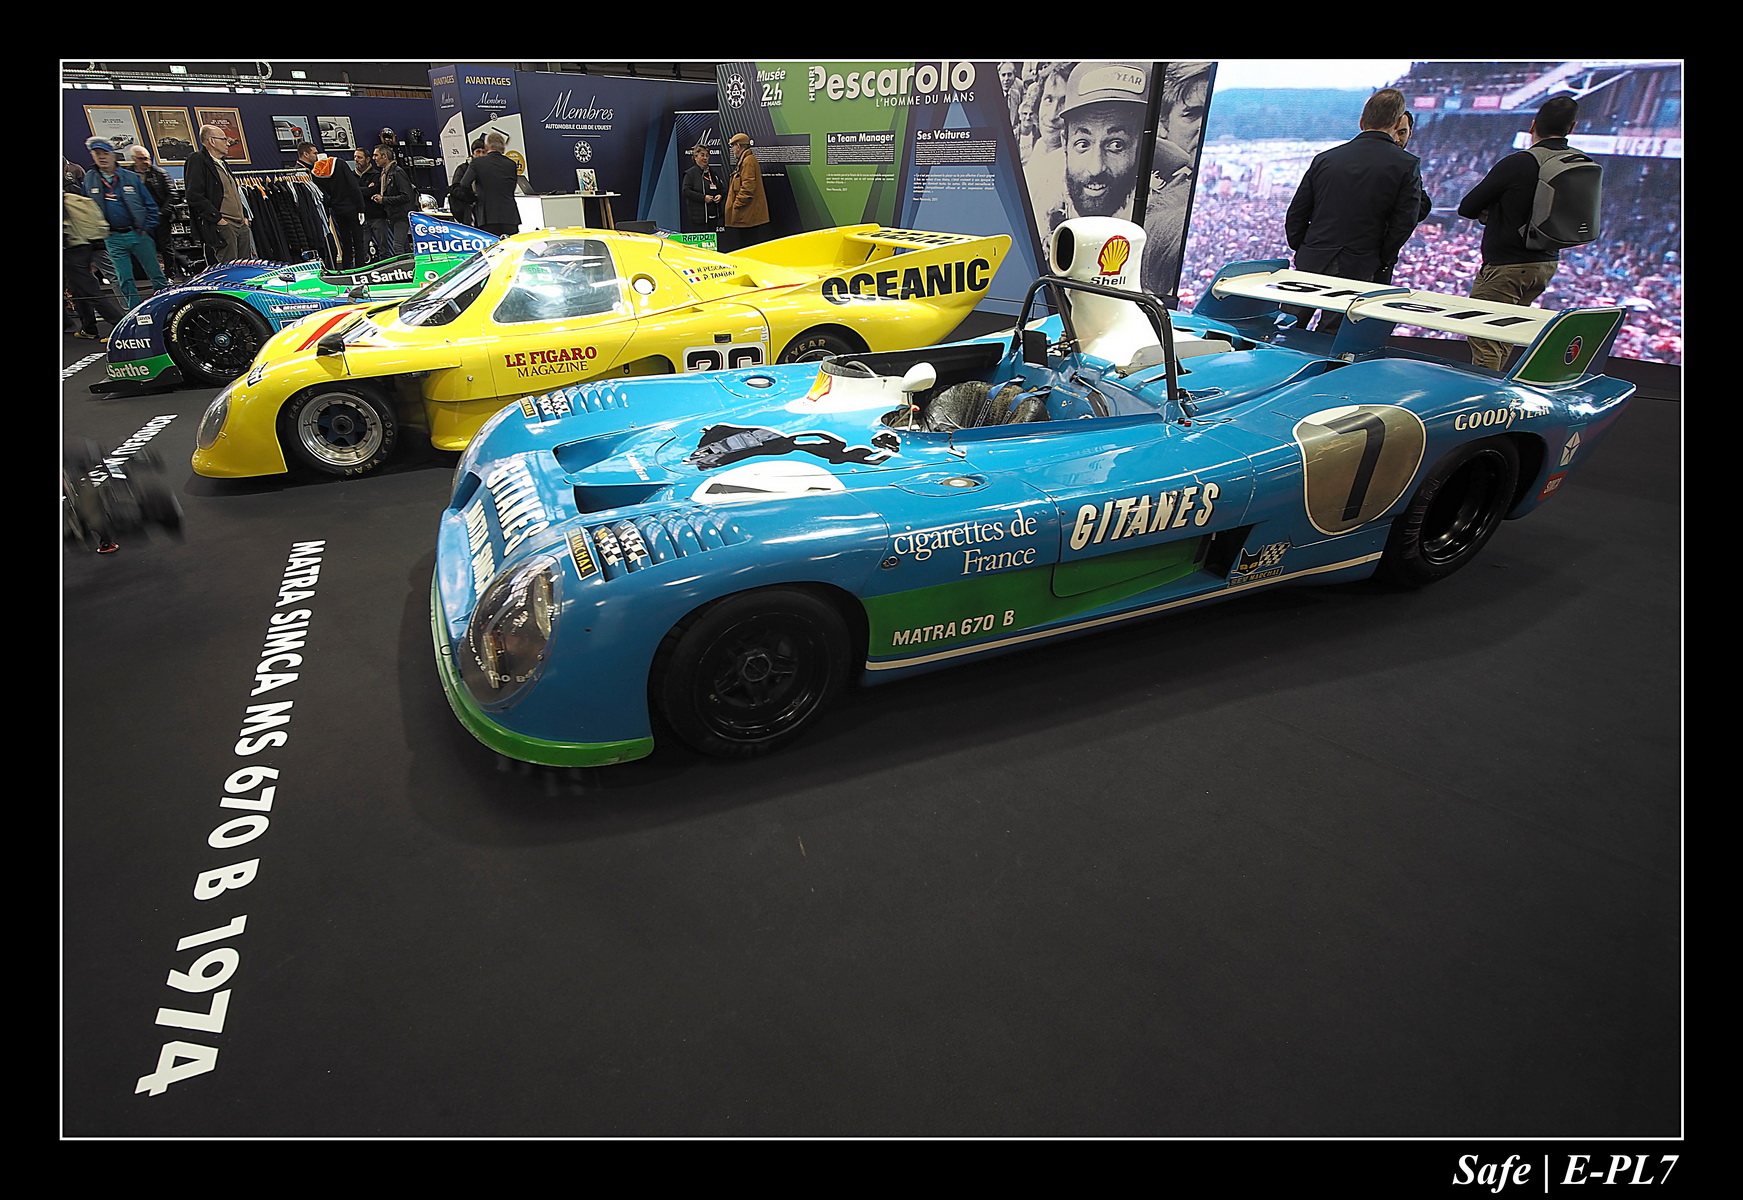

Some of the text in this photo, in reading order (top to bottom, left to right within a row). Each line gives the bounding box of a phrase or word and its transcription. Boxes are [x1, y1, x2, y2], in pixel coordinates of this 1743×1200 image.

[465, 75, 512, 86] AVANTAGES
[756, 67, 786, 82] Musée
[808, 66, 816, 101] HENRI
[814, 61, 976, 100] Pescarolo
[1116, 72, 1143, 86] YEAR
[540, 89, 615, 123] Membres
[875, 91, 975, 108] L'HOMME DU MANS
[827, 132, 895, 144] Le Team Manager
[916, 129, 970, 140] Ses Voitures
[416, 239, 493, 254] PEUGEOT
[351, 268, 414, 285] La Sarthe
[821, 257, 991, 306] OCEANIC
[1091, 275, 1127, 286] Shell
[107, 363, 151, 379] Sarthe
[504, 345, 598, 368] LE FIGARO
[516, 360, 589, 378] MAGAZINE
[110, 414, 179, 456] RONDEAU
[1323, 410, 1386, 523] 7
[486, 459, 551, 557] GITANES
[1069, 482, 1221, 551] GITANES
[893, 510, 1038, 561] cigarettes de
[571, 534, 595, 573] MARCHAL
[960, 545, 1037, 576] France
[892, 609, 1016, 647] MATRA 670 B
[134, 540, 327, 1097] MATRA SIMCA MS 670 B 1974
